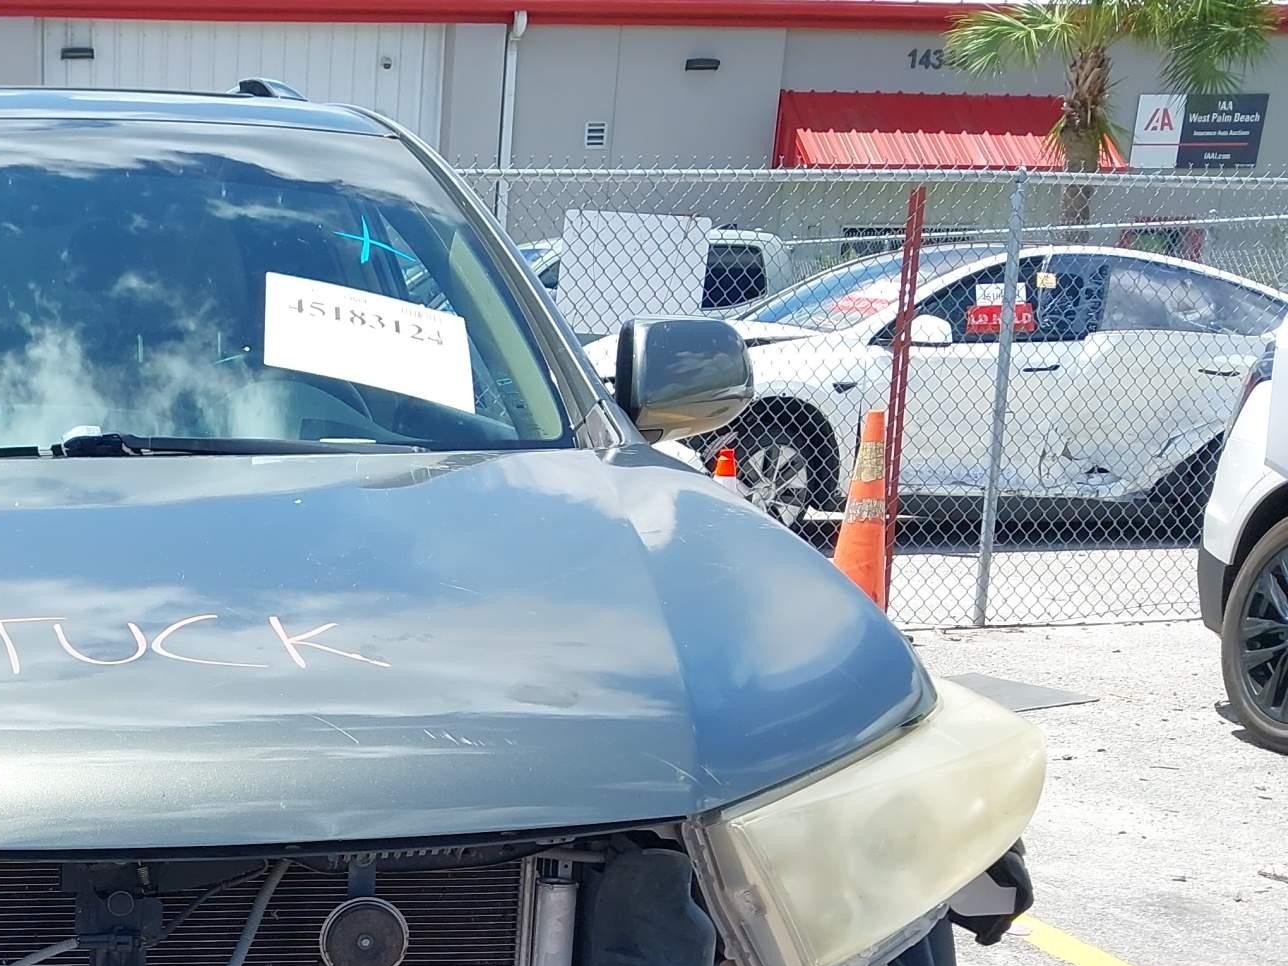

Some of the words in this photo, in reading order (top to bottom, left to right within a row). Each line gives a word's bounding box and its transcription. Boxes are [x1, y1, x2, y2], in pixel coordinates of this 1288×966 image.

[1218, 101, 1233, 111] IAA
[1189, 112, 1210, 123] West
[1211, 112, 1232, 123] Palm
[1233, 112, 1260, 122] Beach
